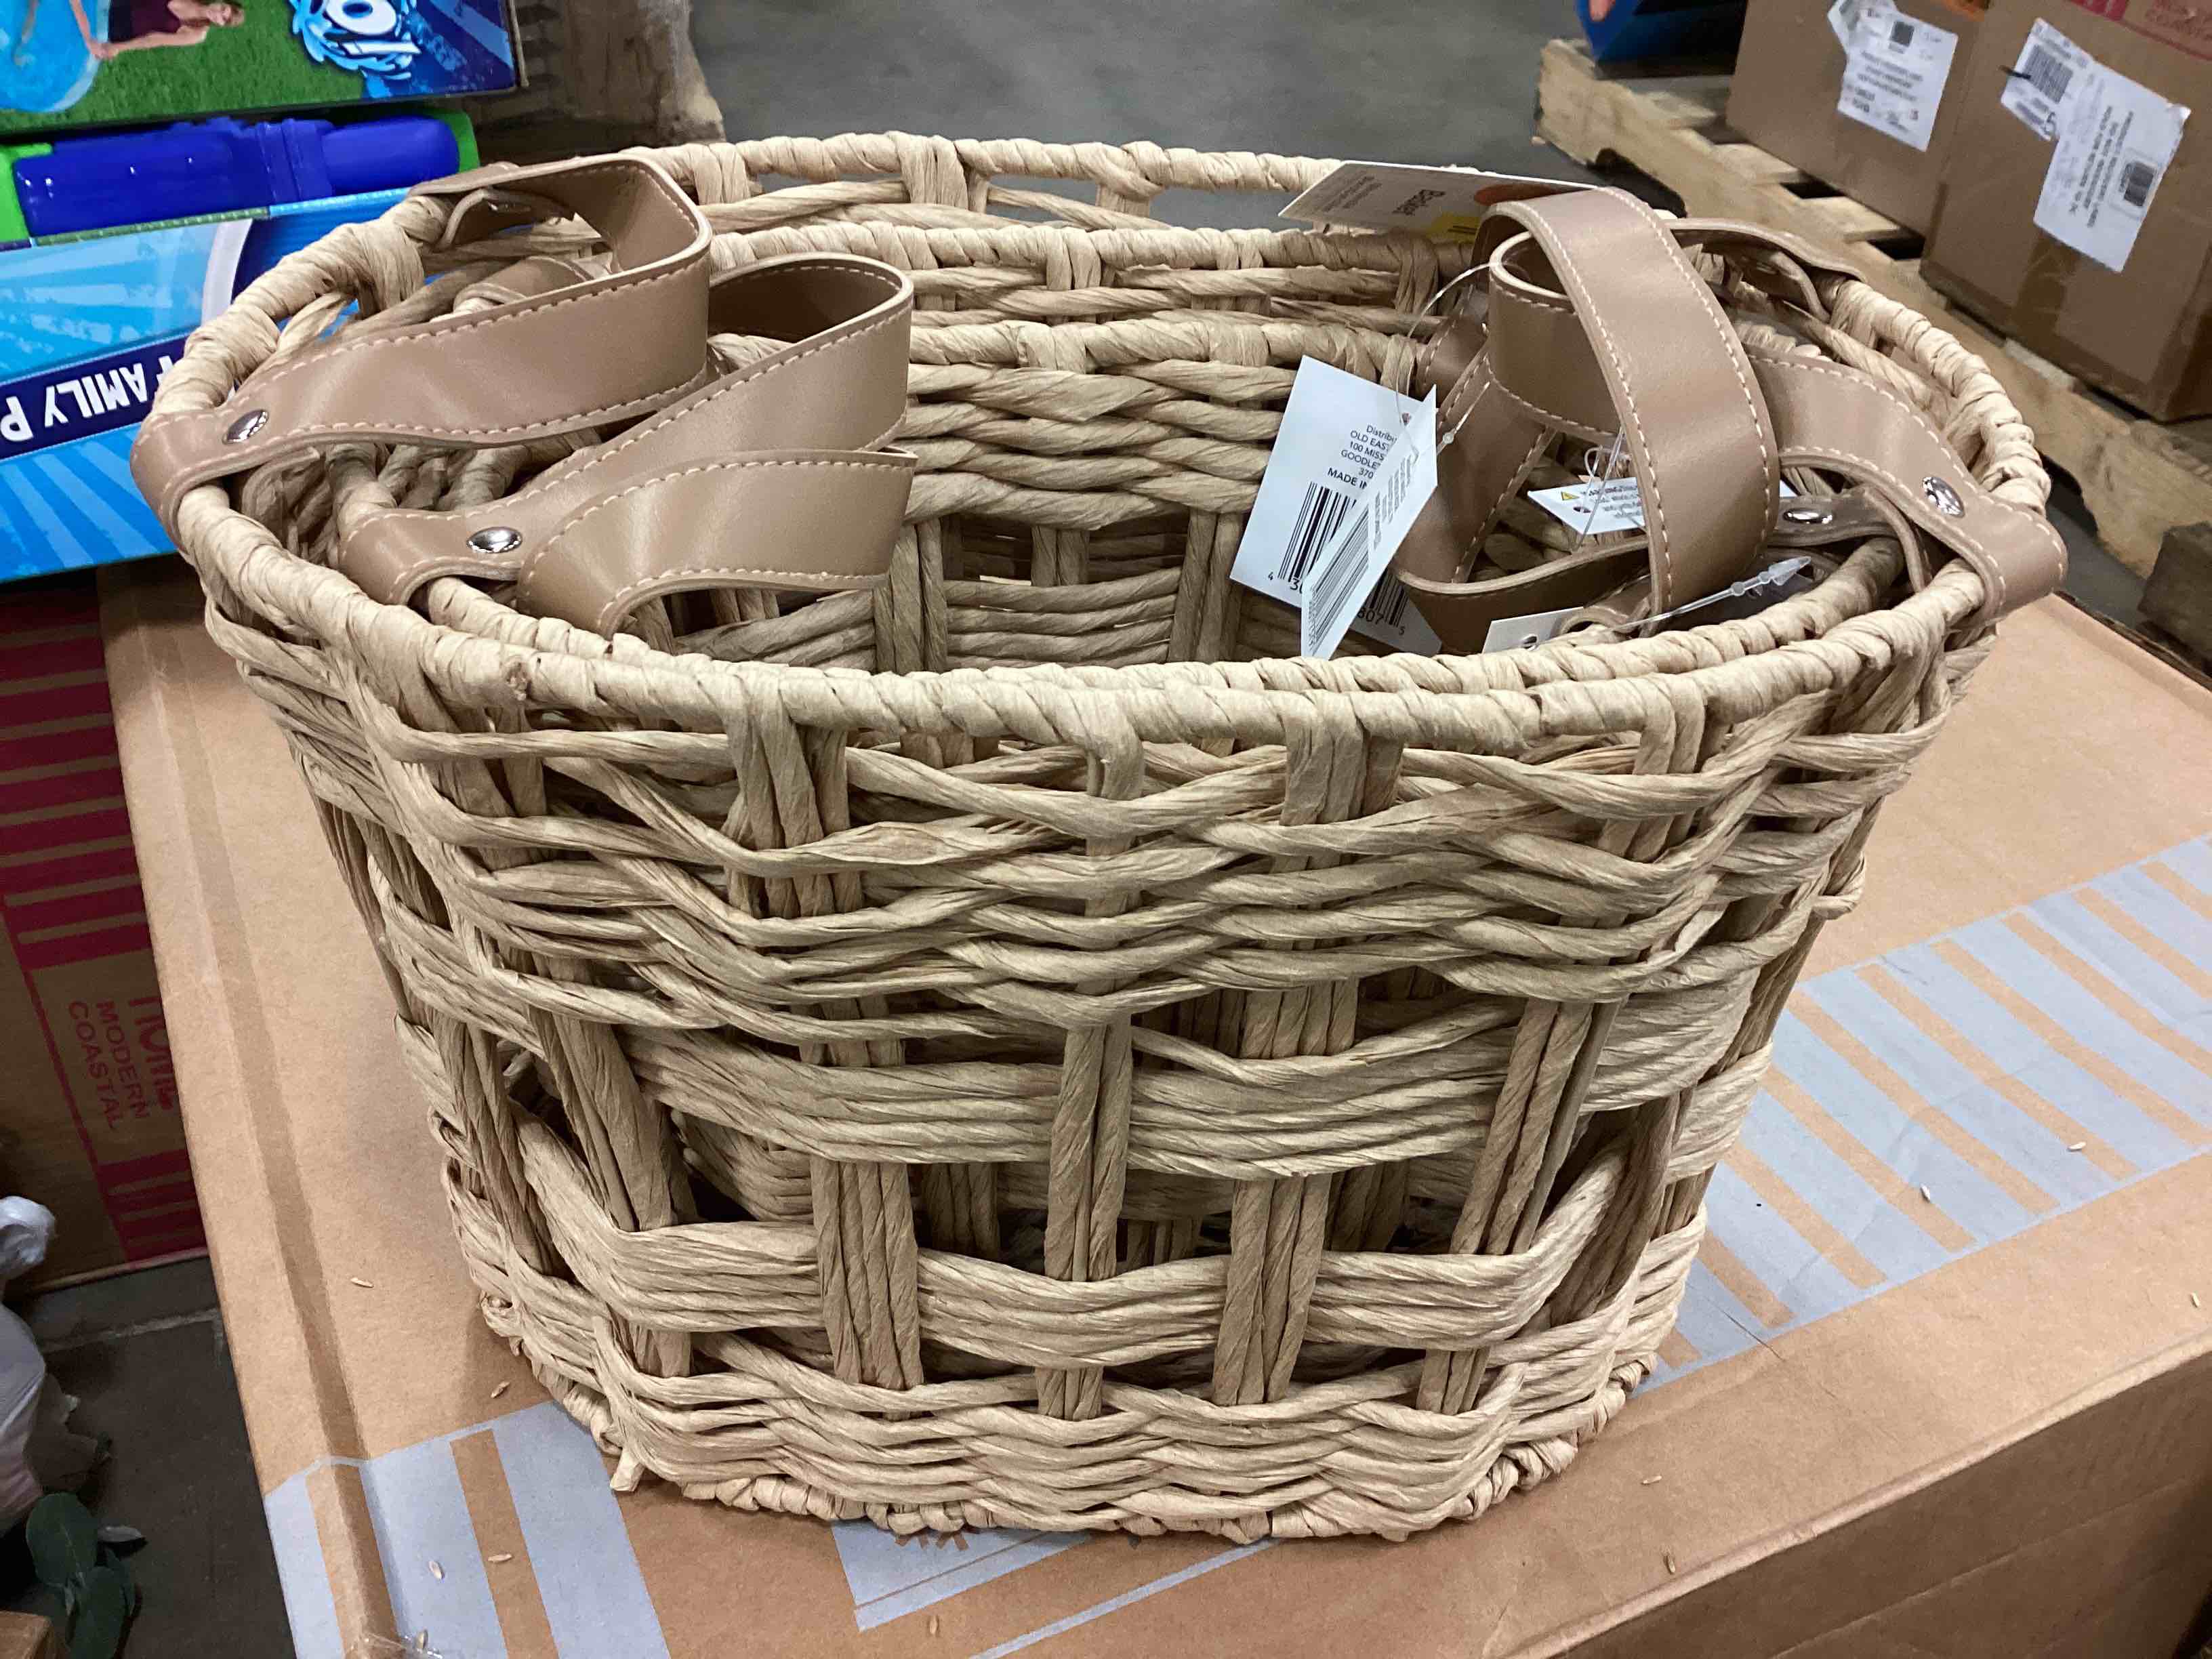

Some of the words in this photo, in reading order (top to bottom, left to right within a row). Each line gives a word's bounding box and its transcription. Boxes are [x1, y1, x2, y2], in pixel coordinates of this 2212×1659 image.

[1350, 430, 1368, 443] OLD
[1370, 438, 1388, 451] EAS
[1350, 441, 1364, 452] 100
[1364, 447, 1385, 462] MISS
[1328, 468, 1357, 486] MADE
[1358, 468, 1374, 479] 370
[1268, 571, 1274, 581] 4
[1398, 626, 1406, 636] 5
[68, 1001, 124, 1130] COASTAL
[96, 1000, 150, 1118] MODERN
